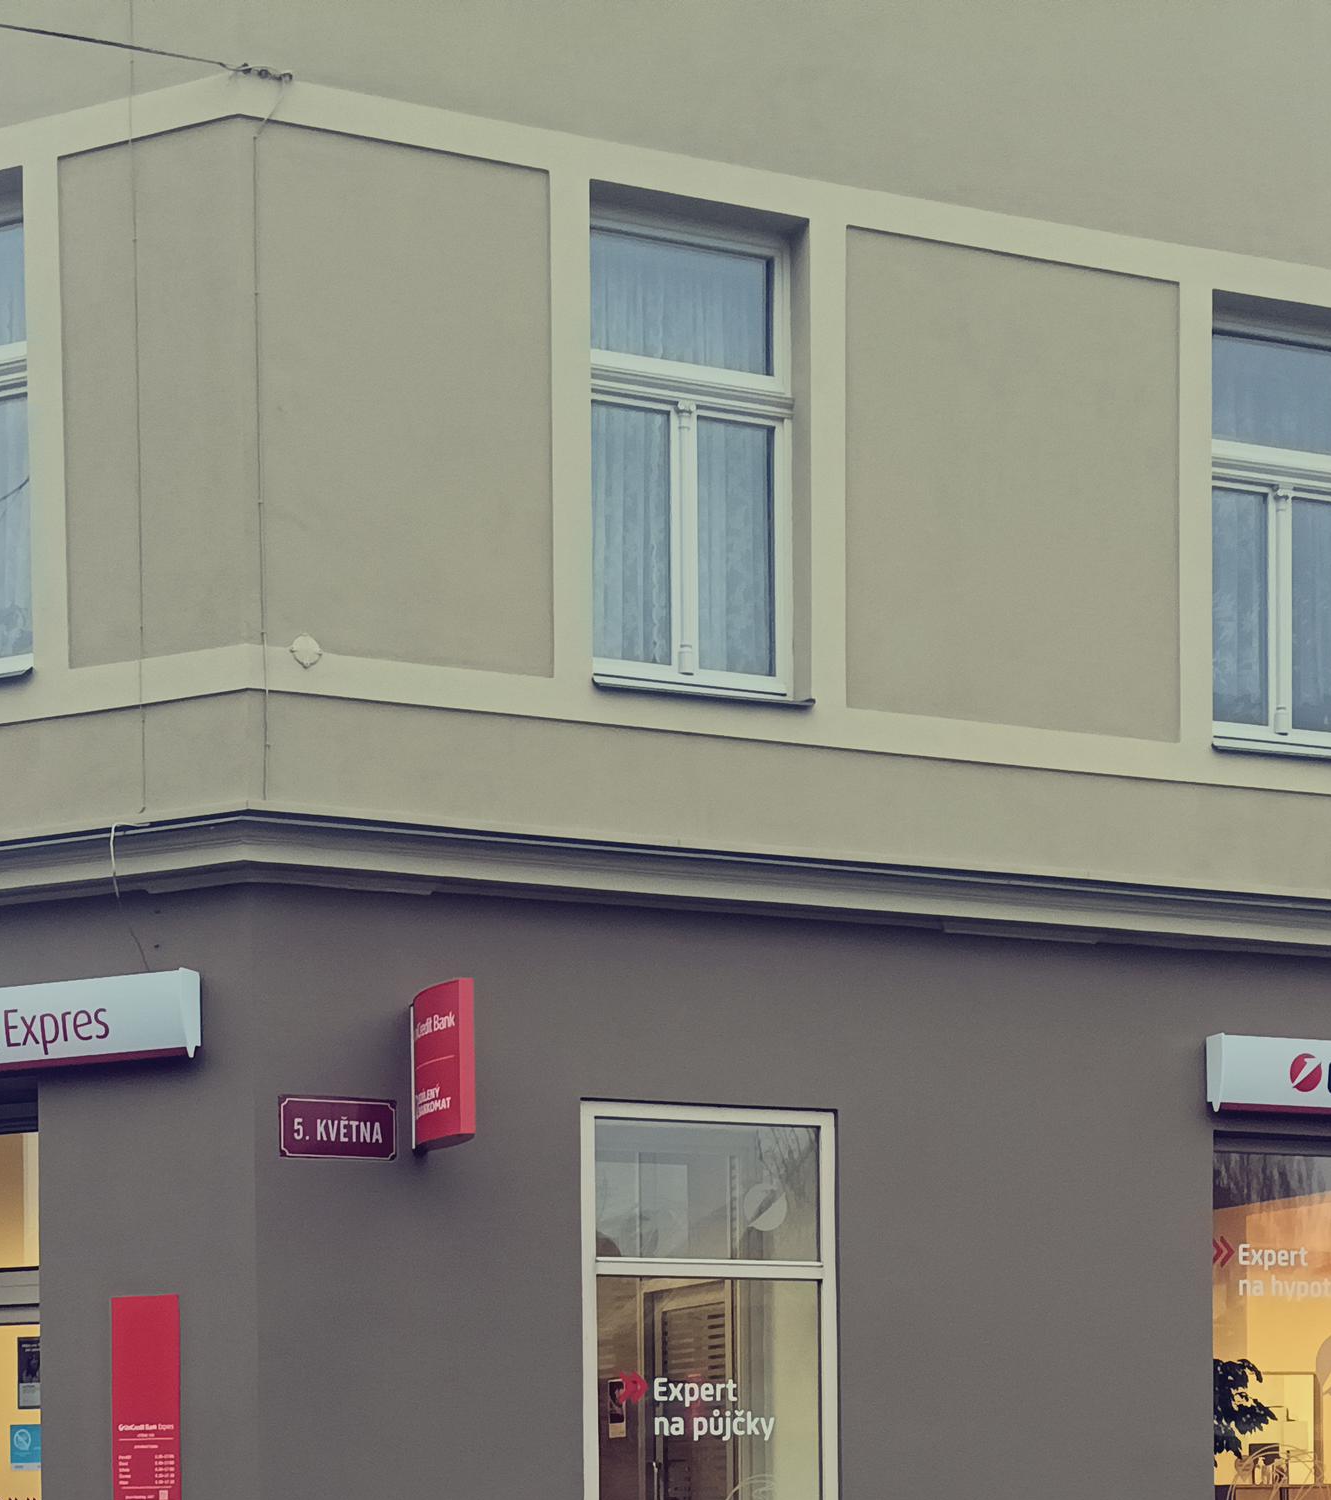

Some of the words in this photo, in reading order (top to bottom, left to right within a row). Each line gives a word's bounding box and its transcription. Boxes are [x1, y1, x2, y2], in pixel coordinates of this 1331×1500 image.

[4, 1007, 110, 1055] Expres
[433, 1012, 456, 1031] Bank
[293, 1117, 310, 1141] 5.
[316, 1116, 383, 1144] KVĚTNA
[1238, 1243, 1308, 1271] Expert
[1238, 1279, 1264, 1297] na
[653, 1377, 738, 1408] Expert
[654, 1415, 685, 1436] na
[693, 1409, 775, 1441] půjčky
